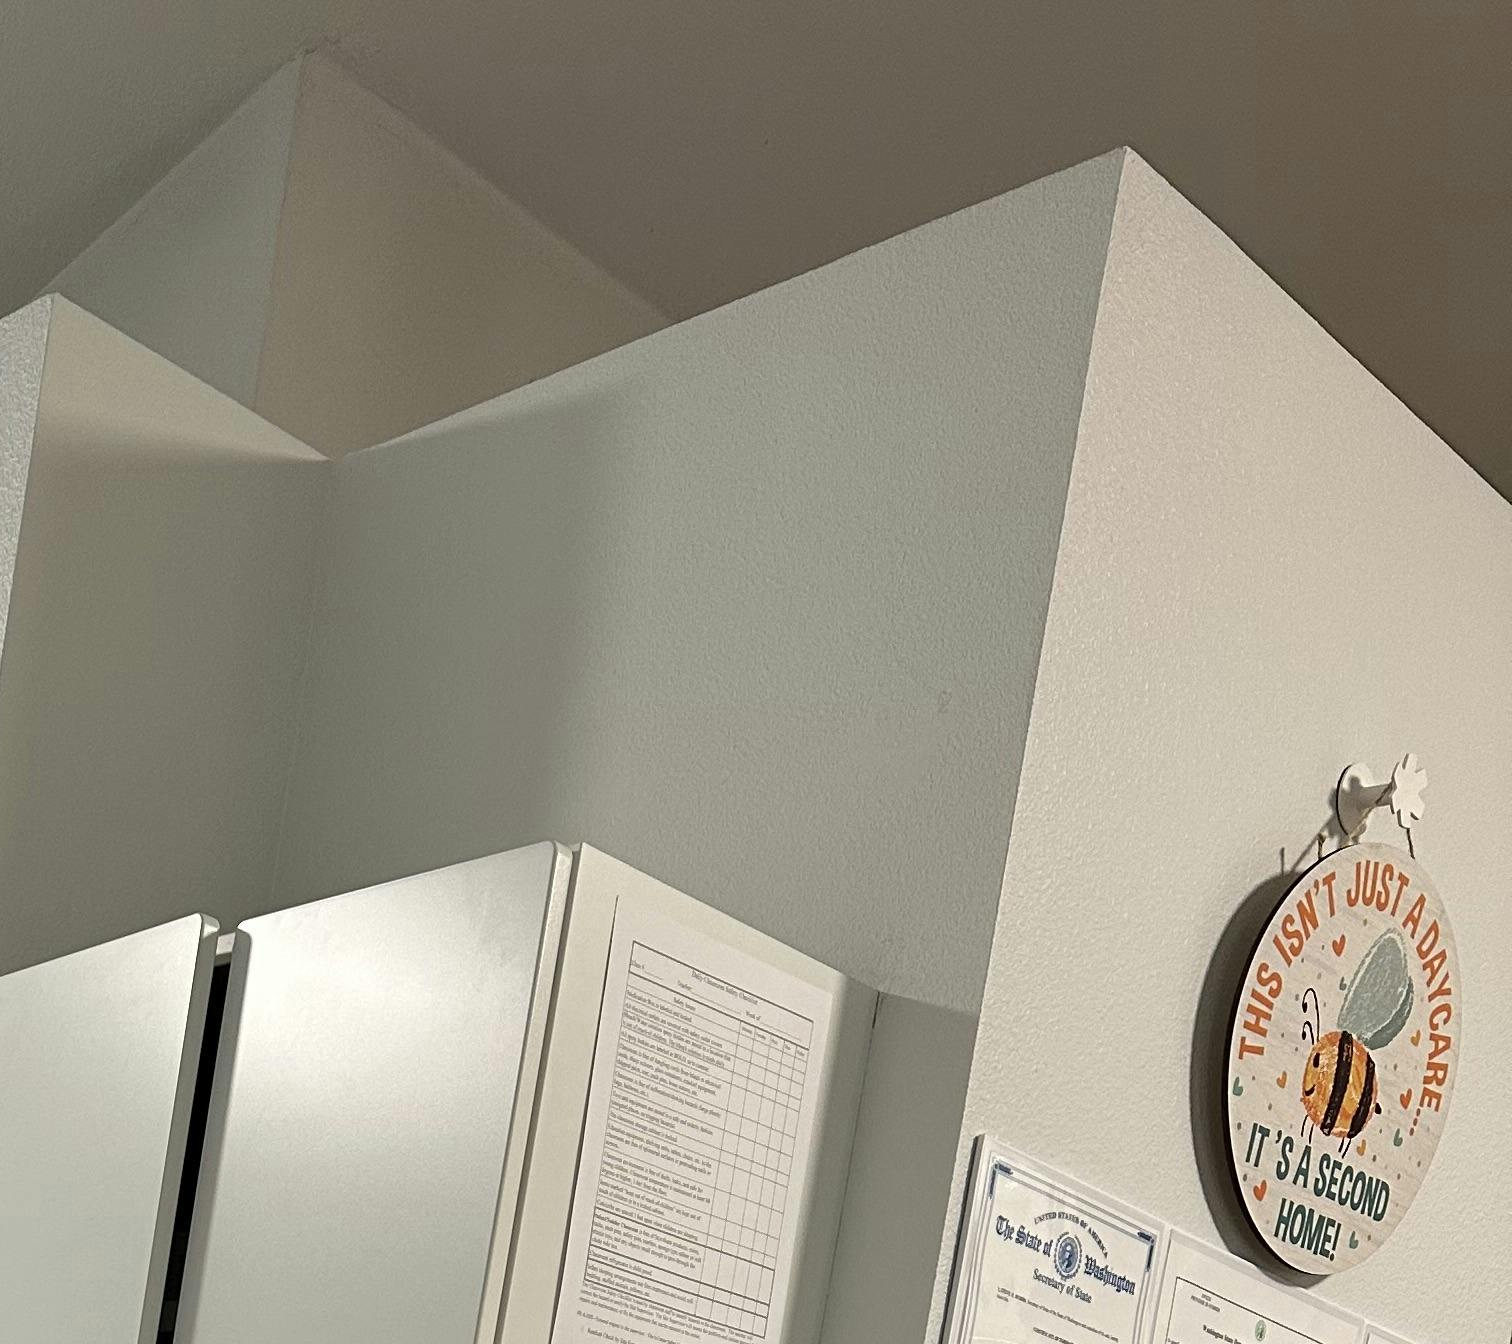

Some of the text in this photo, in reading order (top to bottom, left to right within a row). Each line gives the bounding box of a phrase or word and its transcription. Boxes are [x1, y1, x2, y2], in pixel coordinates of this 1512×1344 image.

[1238, 860, 1454, 1137] THIS ISN'T JUST A DAYCARE...
[1034, 1212, 1056, 1224] UNITED
[1057, 1212, 1079, 1225] STATES
[1293, 1146, 1311, 1188] A
[1313, 1153, 1390, 1223] SECOND
[995, 1215, 1136, 1295] The State of Washington
[1273, 1198, 1341, 1261] HOME!
[1033, 1268, 1092, 1304] Secretary of State
